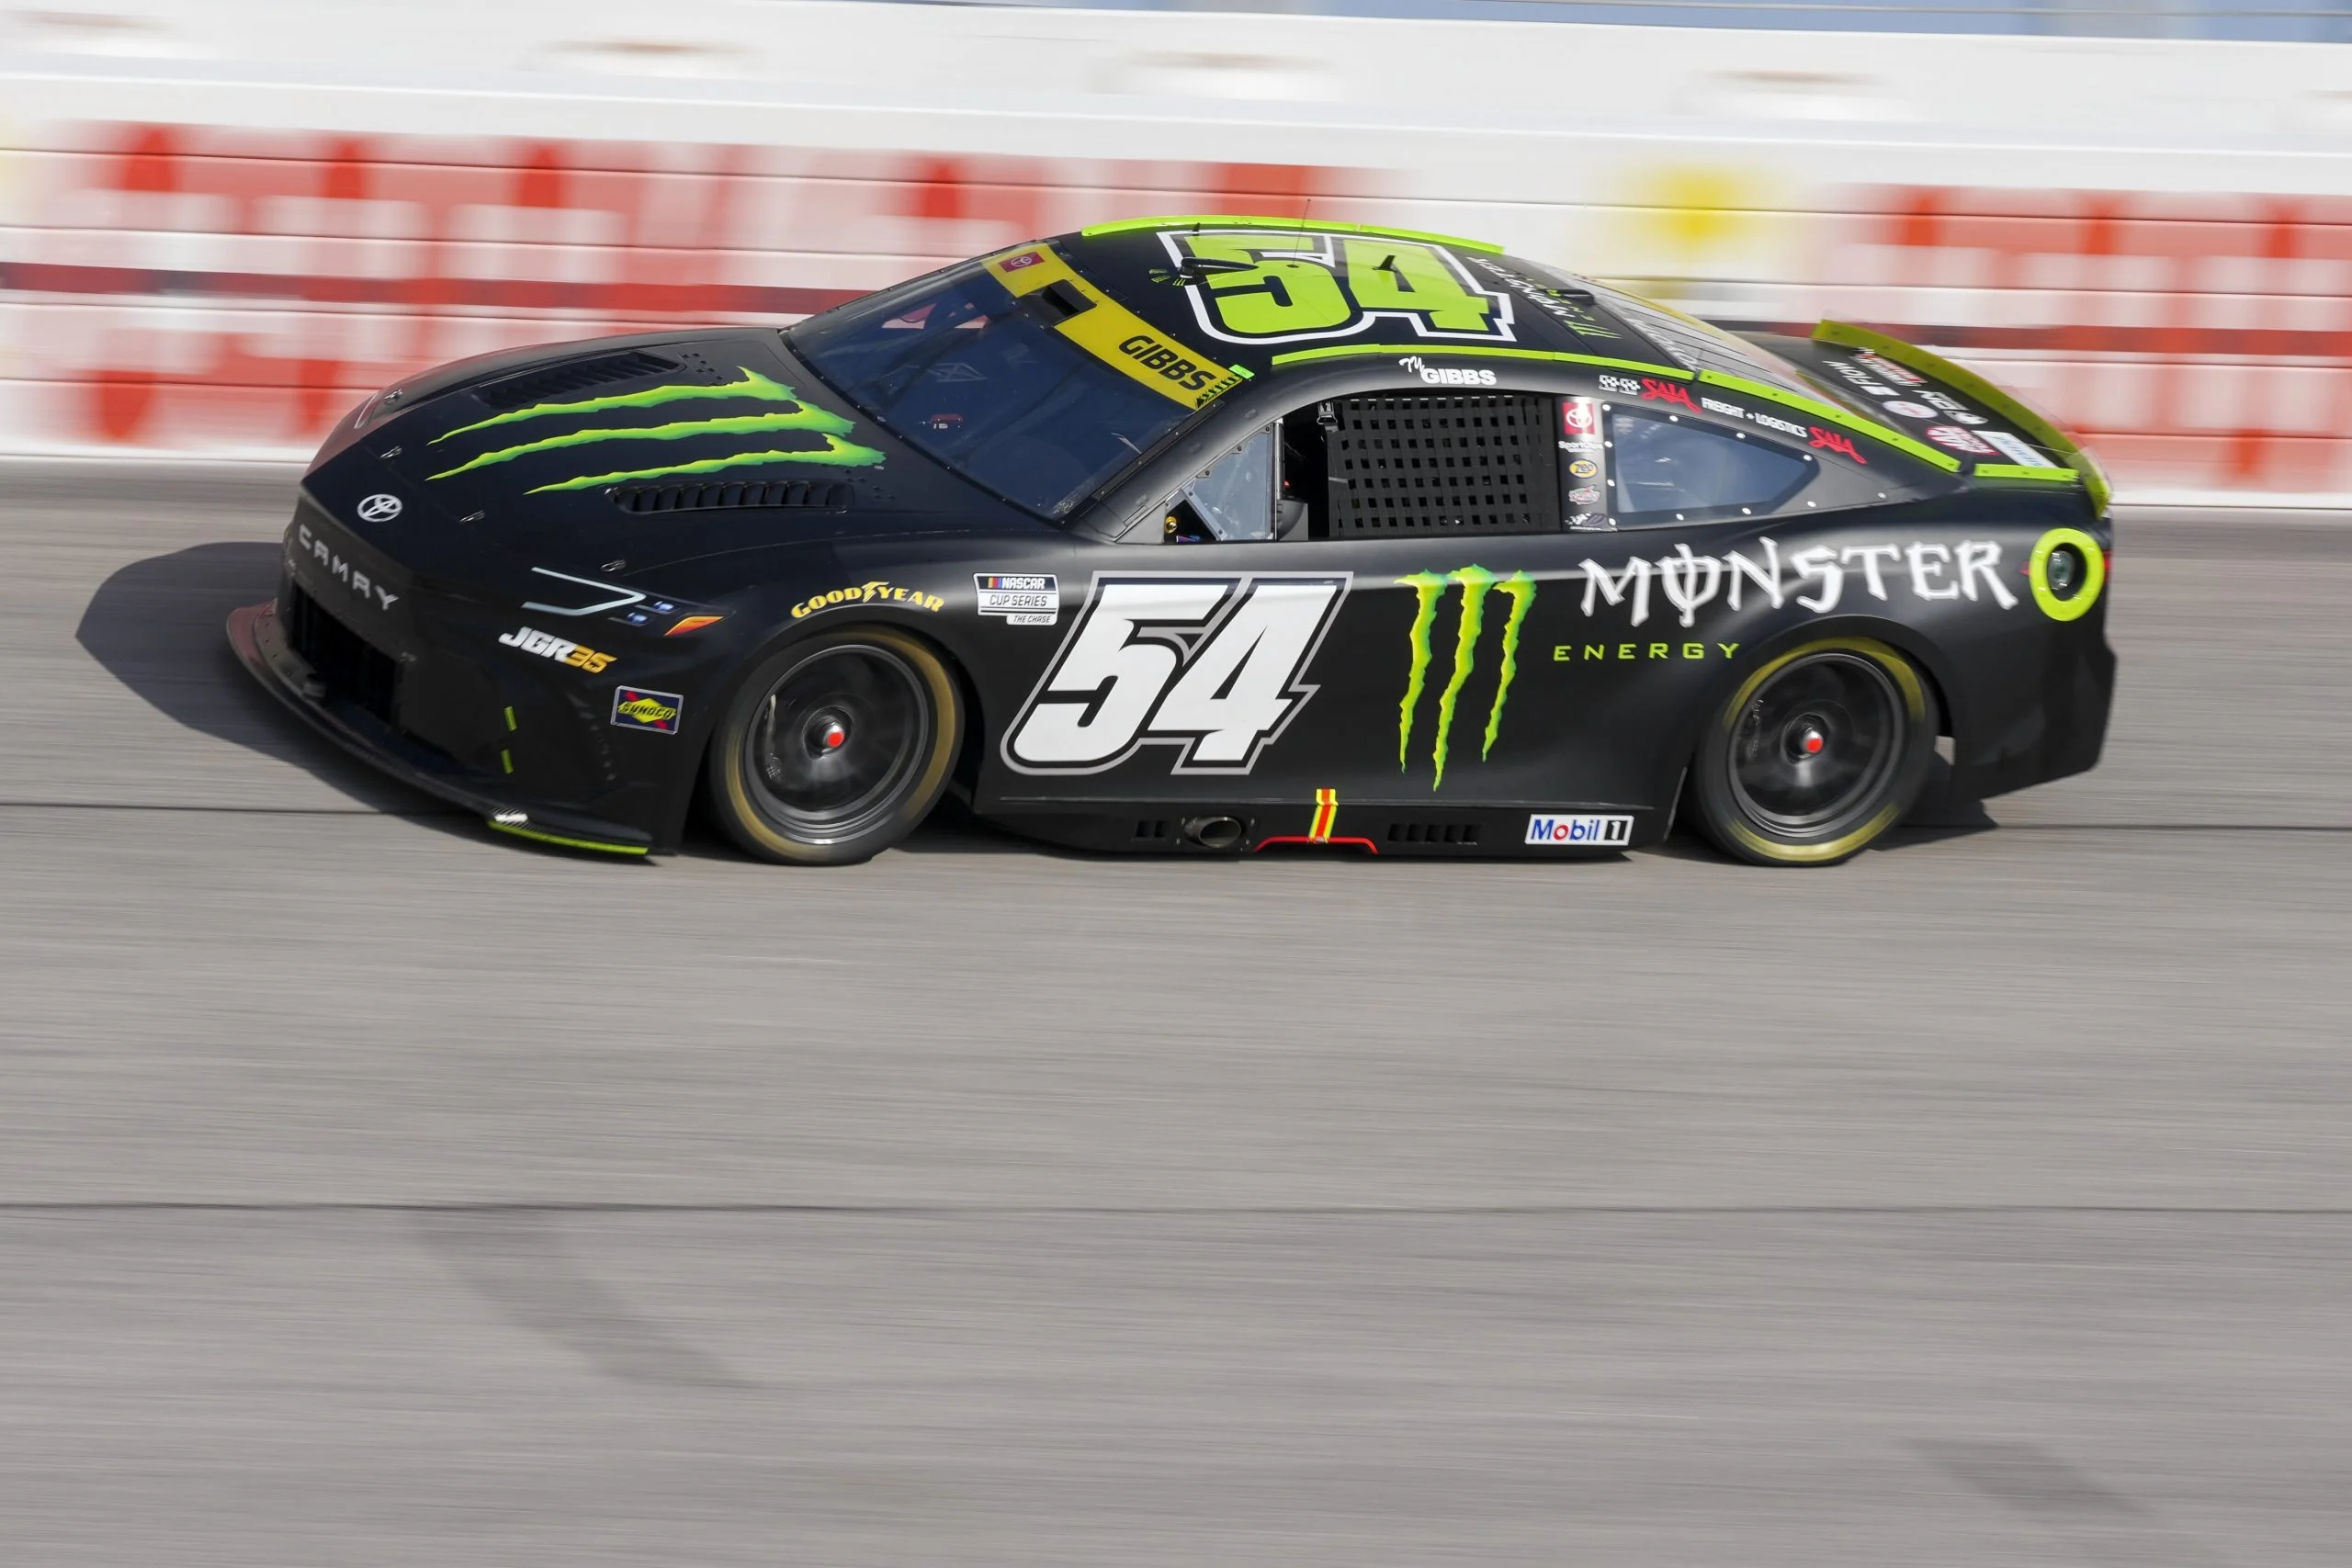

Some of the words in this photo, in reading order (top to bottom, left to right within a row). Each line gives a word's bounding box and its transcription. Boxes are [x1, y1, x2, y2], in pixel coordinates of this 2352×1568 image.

[1183, 233, 1490, 334] 54
[1118, 334, 1217, 391] GIBBS
[1420, 367, 1498, 386] GIBBS
[299, 524, 399, 611] CAMRY
[1001, 577, 1046, 590] NASCAR
[1577, 536, 2019, 627] MONSTER
[791, 581, 945, 619] GOODYEAR
[989, 594, 1011, 606] CUP
[1012, 594, 1048, 607] SERIES
[1013, 615, 1027, 624] THE
[1027, 615, 1052, 625] CHASE
[1553, 642, 1740, 662] ENERGY
[1012, 582, 1339, 761] 54
[621, 701, 675, 720] SUNOCO
[1530, 818, 1600, 840] Mobil
[1610, 819, 1623, 840] 1
